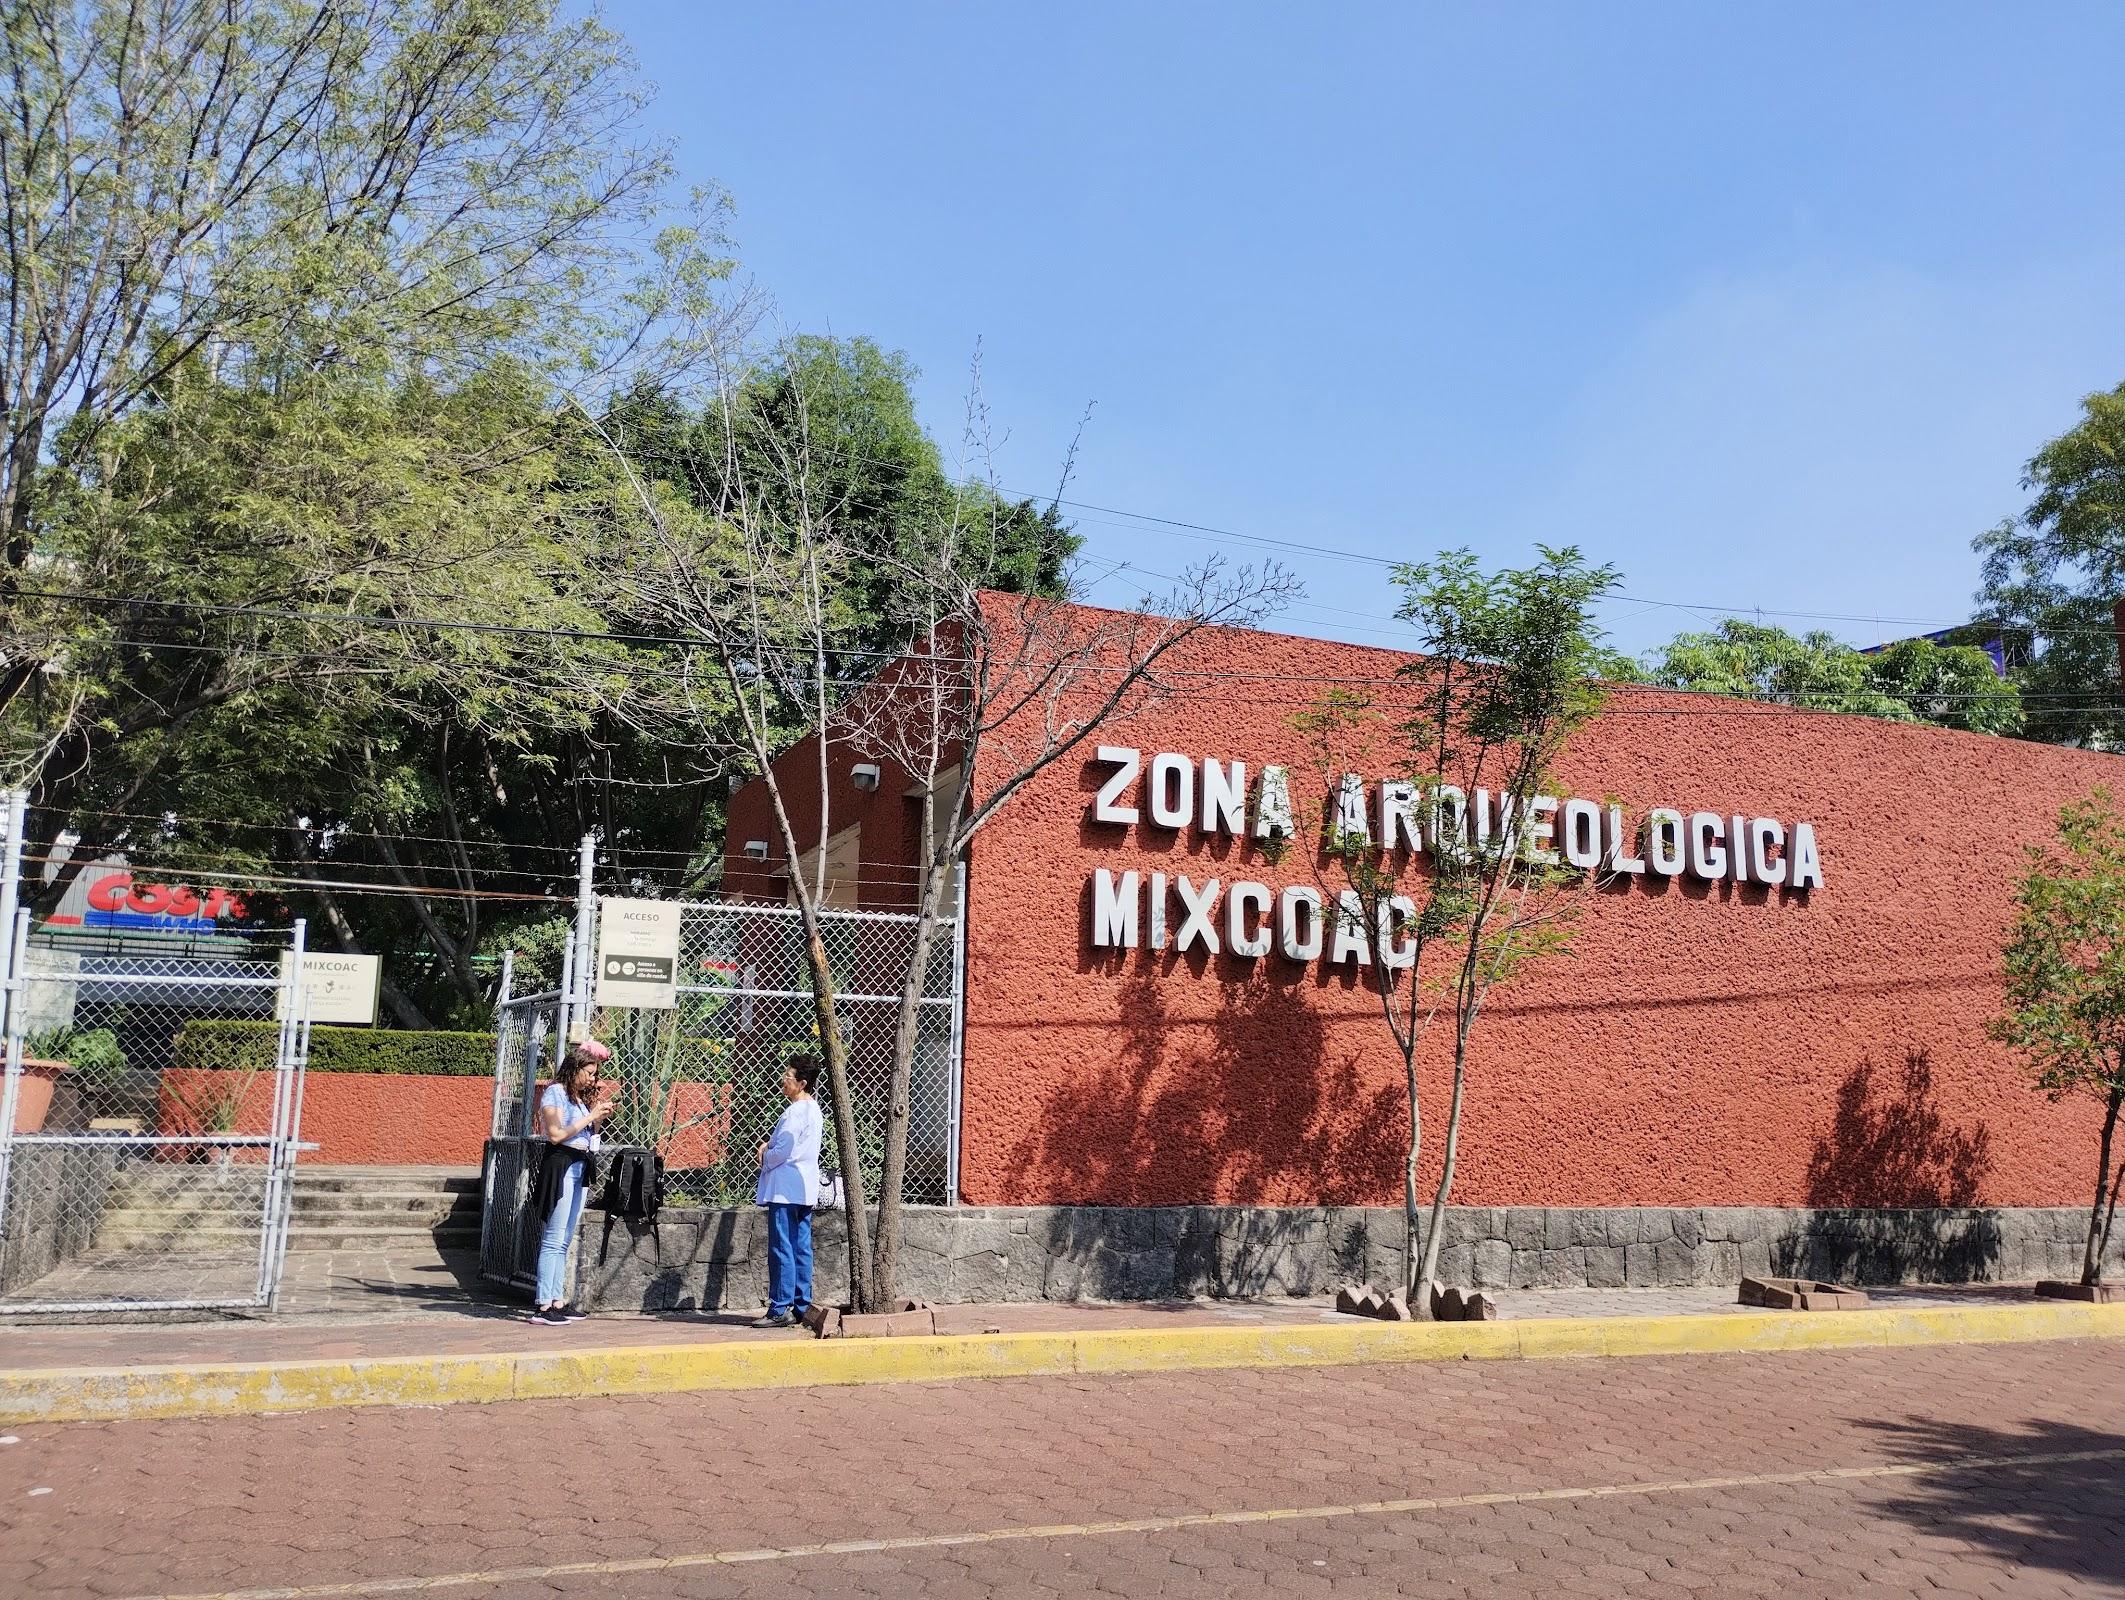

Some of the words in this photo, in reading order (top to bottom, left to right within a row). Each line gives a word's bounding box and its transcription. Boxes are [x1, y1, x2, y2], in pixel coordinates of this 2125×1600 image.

[1093, 745, 1296, 840] ZONA
[1326, 773, 1825, 889] ARQUEOLOGICA
[623, 912, 660, 922] ACCESO
[1092, 868, 1418, 969] MIXCOAC
[303, 961, 359, 972] MIXCOAC
